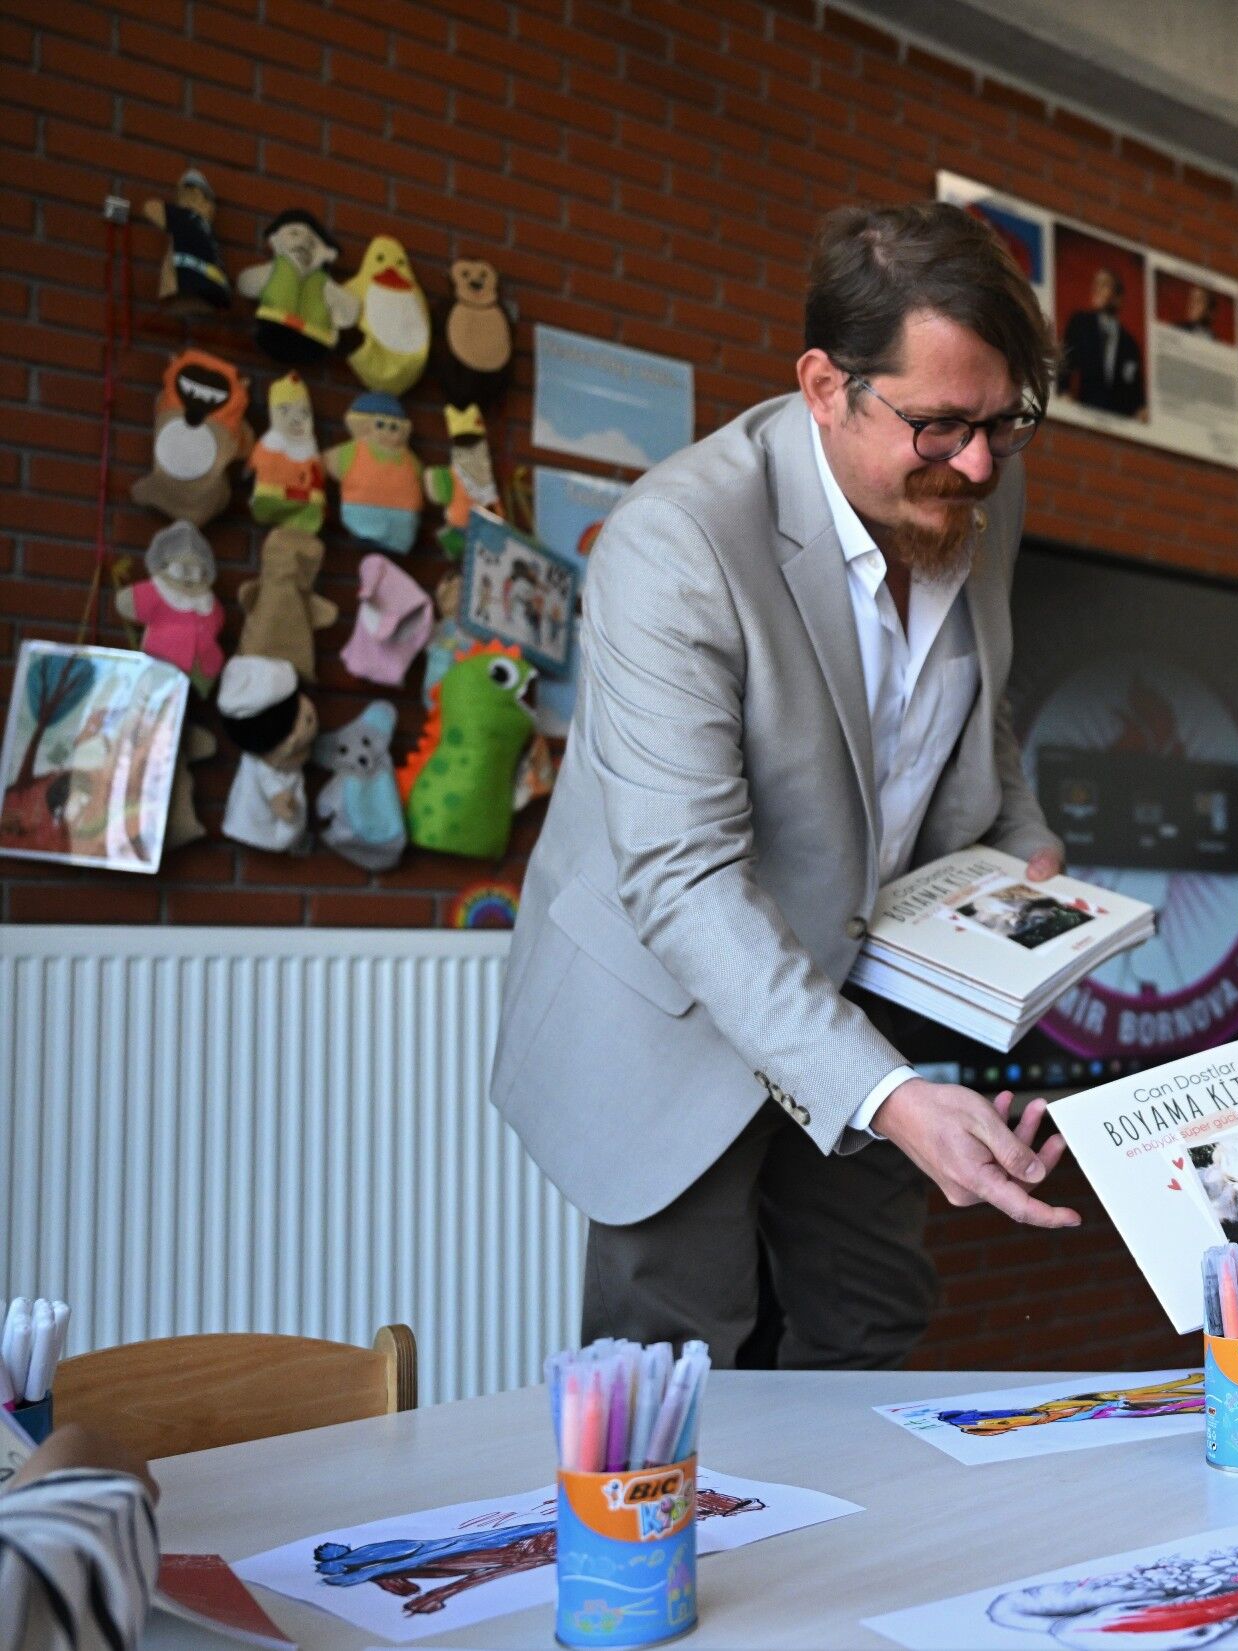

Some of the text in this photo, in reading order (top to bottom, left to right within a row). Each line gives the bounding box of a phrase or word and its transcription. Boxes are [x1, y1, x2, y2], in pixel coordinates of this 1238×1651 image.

[1133, 1061, 1237, 1103] Can Dostlar
[1103, 1093, 1205, 1147] BOYAMA
[1126, 1146, 1142, 1158] en
[1142, 1133, 1178, 1152] büyük
[1180, 1121, 1211, 1139] süper
